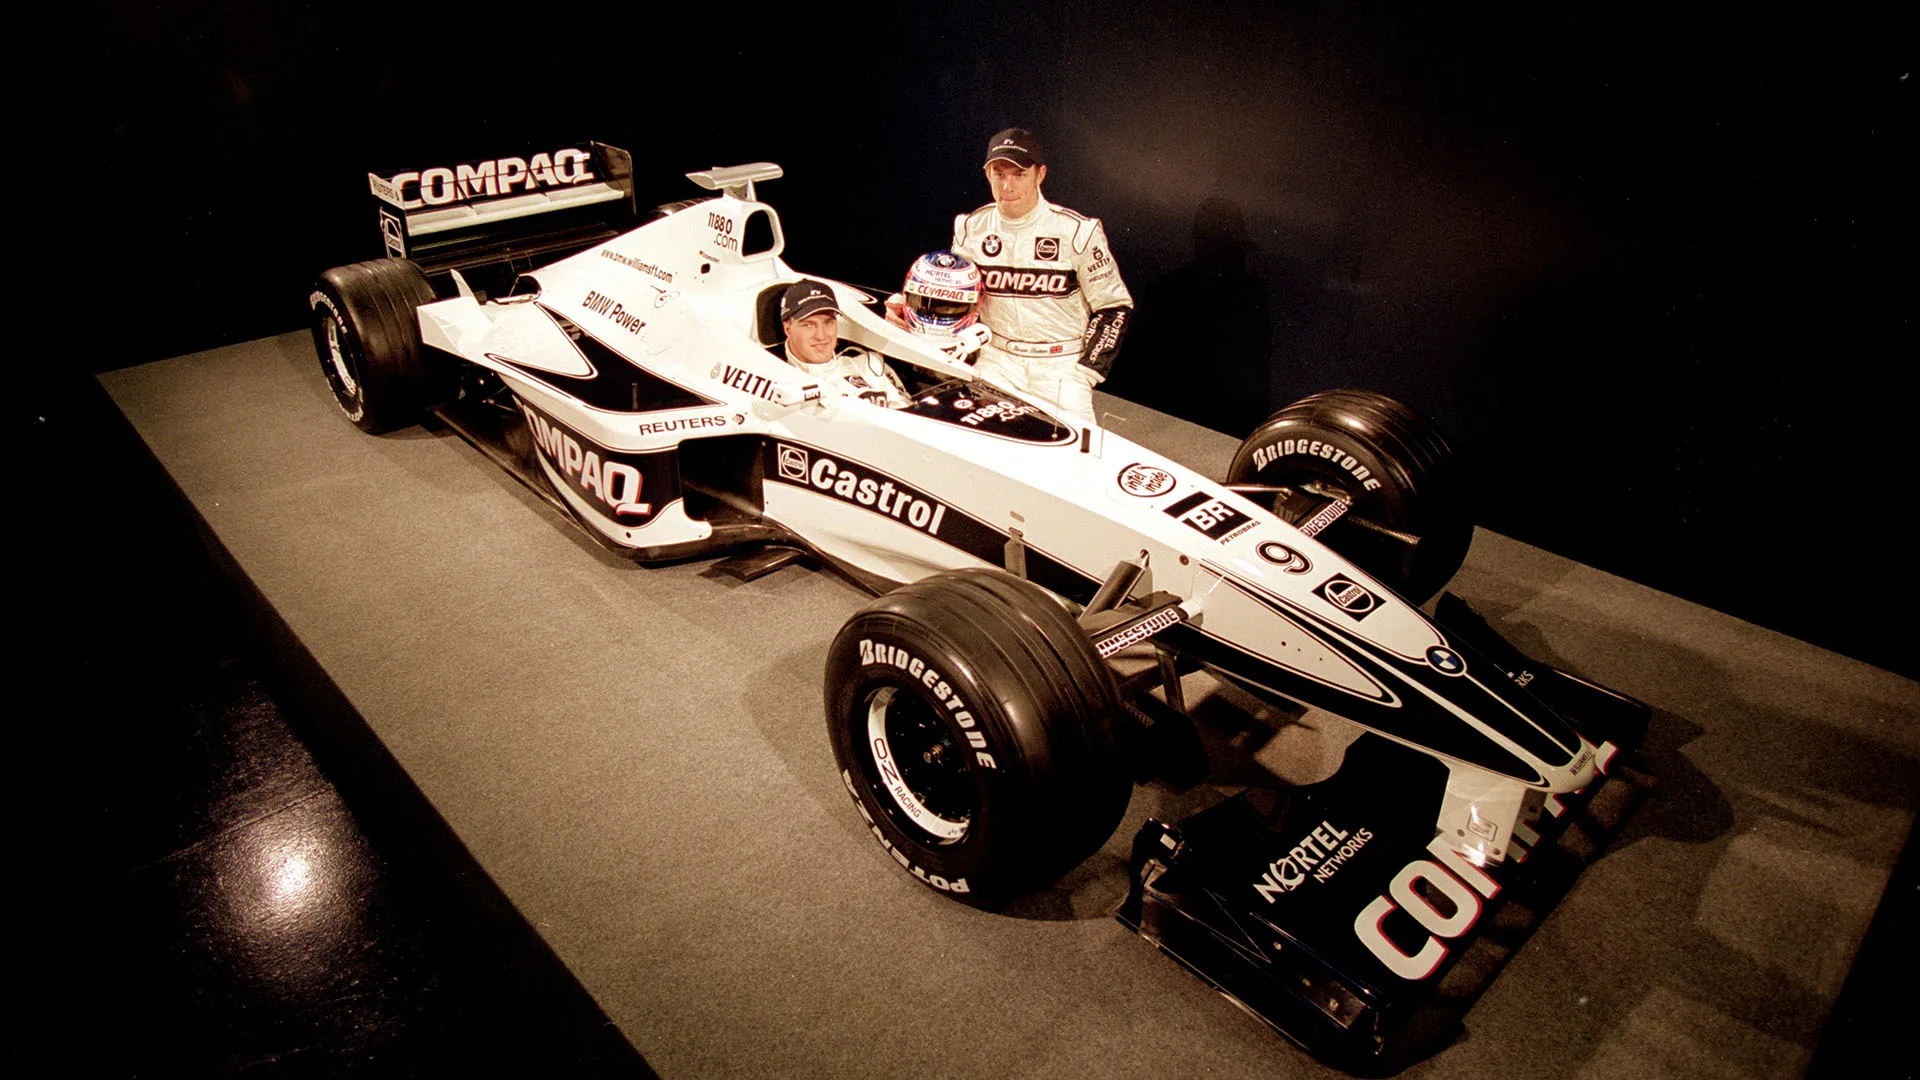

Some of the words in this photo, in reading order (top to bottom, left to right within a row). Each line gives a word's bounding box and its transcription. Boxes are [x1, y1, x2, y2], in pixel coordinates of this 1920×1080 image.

[391, 148, 596, 210] COMPAQ
[708, 212, 733, 235] 11880
[713, 233, 738, 252] .com
[917, 284, 965, 300] COMPAQ
[981, 269, 1068, 293] OMPAQ
[582, 290, 612, 316] BMW
[611, 302, 647, 336] Power
[1104, 311, 1126, 349] NORTEL
[1089, 324, 1111, 364] NETWORKS
[722, 364, 778, 402] VELTI
[639, 414, 727, 436] REUTERS
[960, 401, 1015, 426] 11880
[512, 394, 652, 516] OMPAQ
[1252, 439, 1381, 492] BRIDGESTONE
[811, 458, 946, 535] Castrol
[1192, 500, 1236, 531] BR
[1220, 520, 1261, 546] PETROBRAS
[1255, 540, 1314, 575] 9
[1337, 585, 1363, 606] Castrol
[859, 638, 997, 770] BRIDGESTONE
[894, 785, 922, 819] RACING
[1253, 820, 1349, 904] NORTEL
[1313, 827, 1373, 884] NETWORKS
